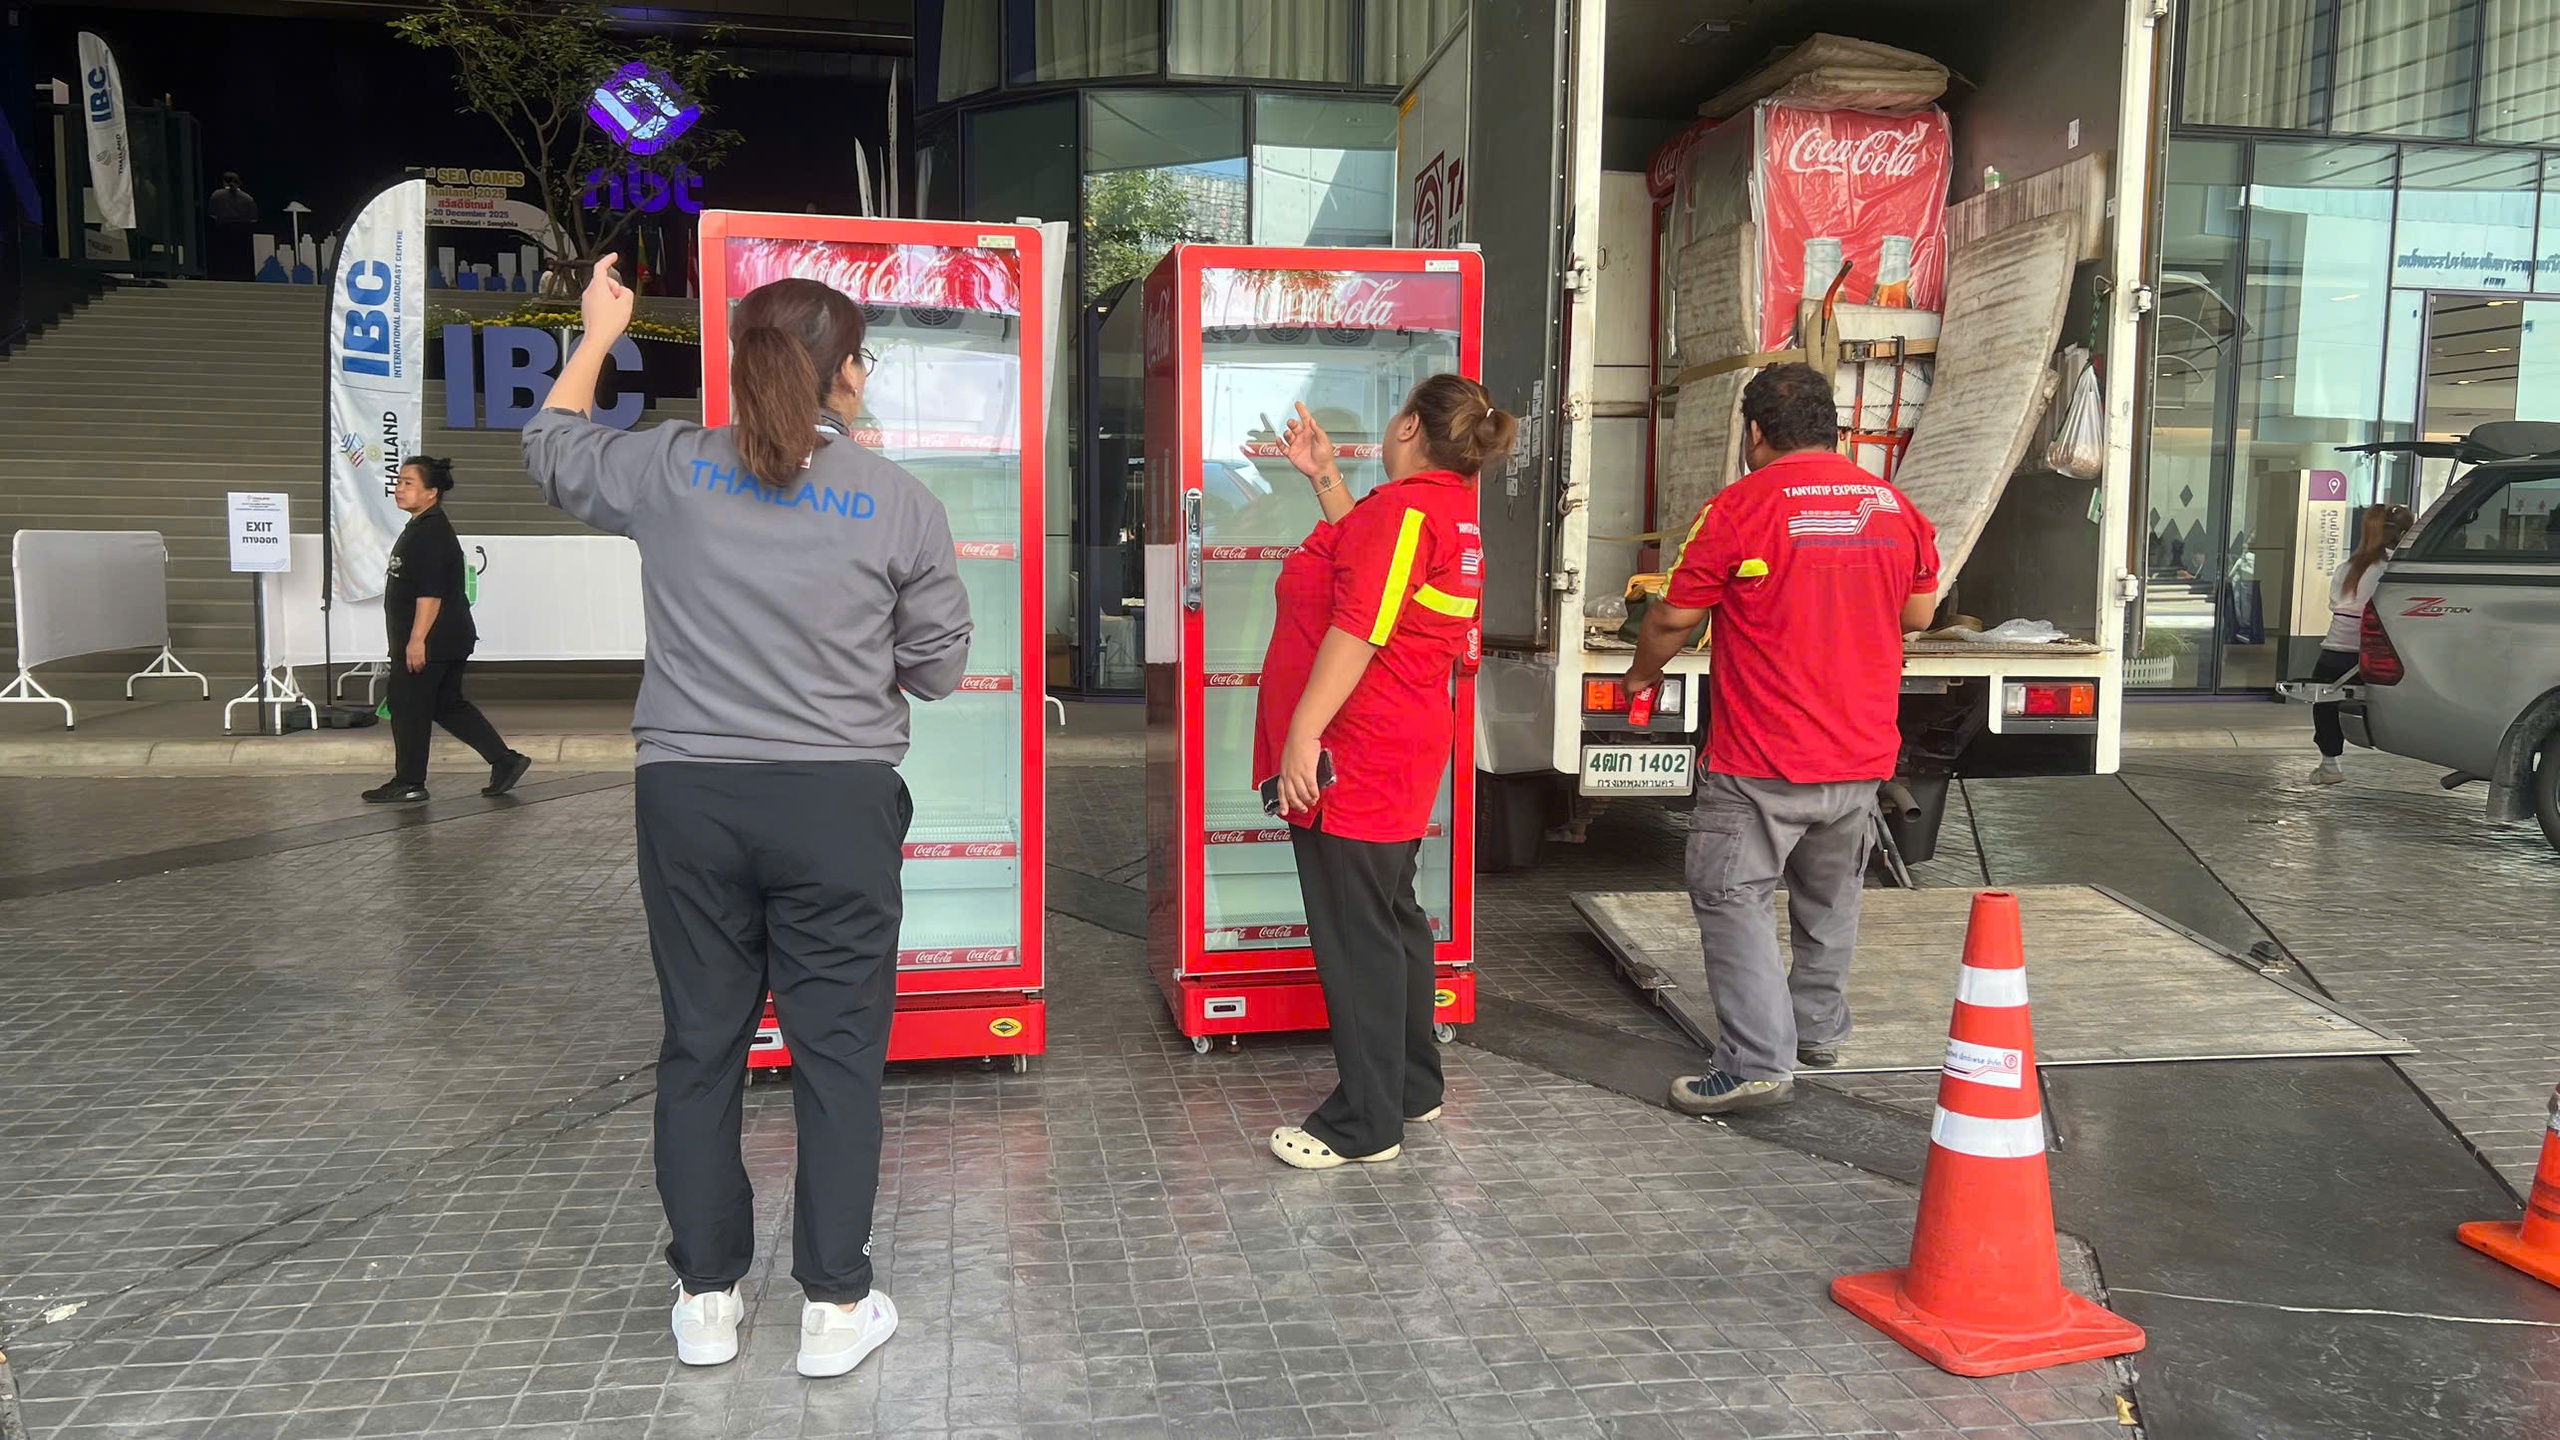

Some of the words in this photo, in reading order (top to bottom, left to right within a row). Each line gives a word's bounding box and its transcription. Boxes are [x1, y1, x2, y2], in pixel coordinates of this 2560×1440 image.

[88, 66, 113, 122] IBC
[1789, 127, 1921, 177] Coca-Cola
[437, 167, 469, 184] SEA
[470, 169, 525, 187] GAMES
[476, 187, 507, 199] 2025
[445, 209, 487, 218] December
[488, 210, 509, 219] 2025
[395, 230, 404, 262] CENTRE
[394, 263, 403, 314] BROADCAST
[342, 260, 392, 377] IBC
[394, 315, 403, 379] INTERNATIONAL
[443, 324, 646, 430] IBC
[383, 411, 399, 498] THAILAND
[1782, 486, 1831, 498] TANYATIP
[1832, 484, 1875, 496] EXPRESS
[246, 521, 273, 533] EXIT
[242, 536, 278, 545] ทางออก
[2400, 596, 2446, 617] Z
[1639, 753, 1686, 773] 1402
[1597, 779, 1675, 788] กรงเทพมหานคร
